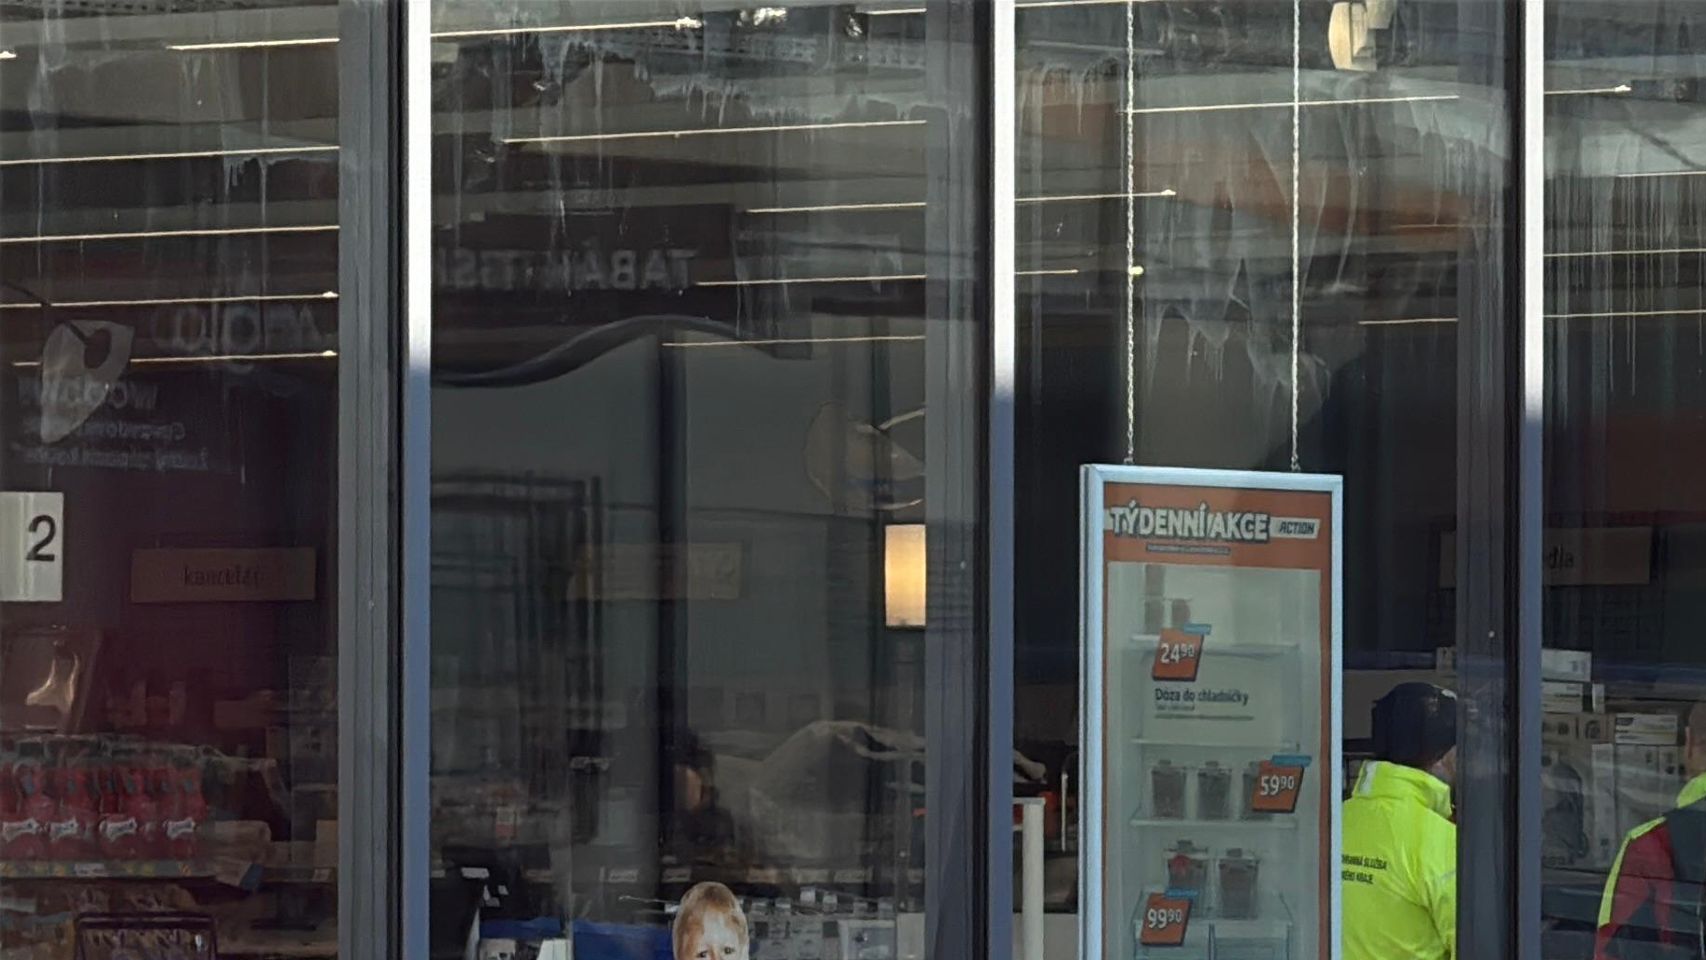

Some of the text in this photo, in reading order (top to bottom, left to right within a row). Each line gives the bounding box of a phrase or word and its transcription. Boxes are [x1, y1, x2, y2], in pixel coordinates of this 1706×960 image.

[26, 515, 56, 562] 2
[1110, 500, 1270, 541] TÝDENNÍ AKCE
